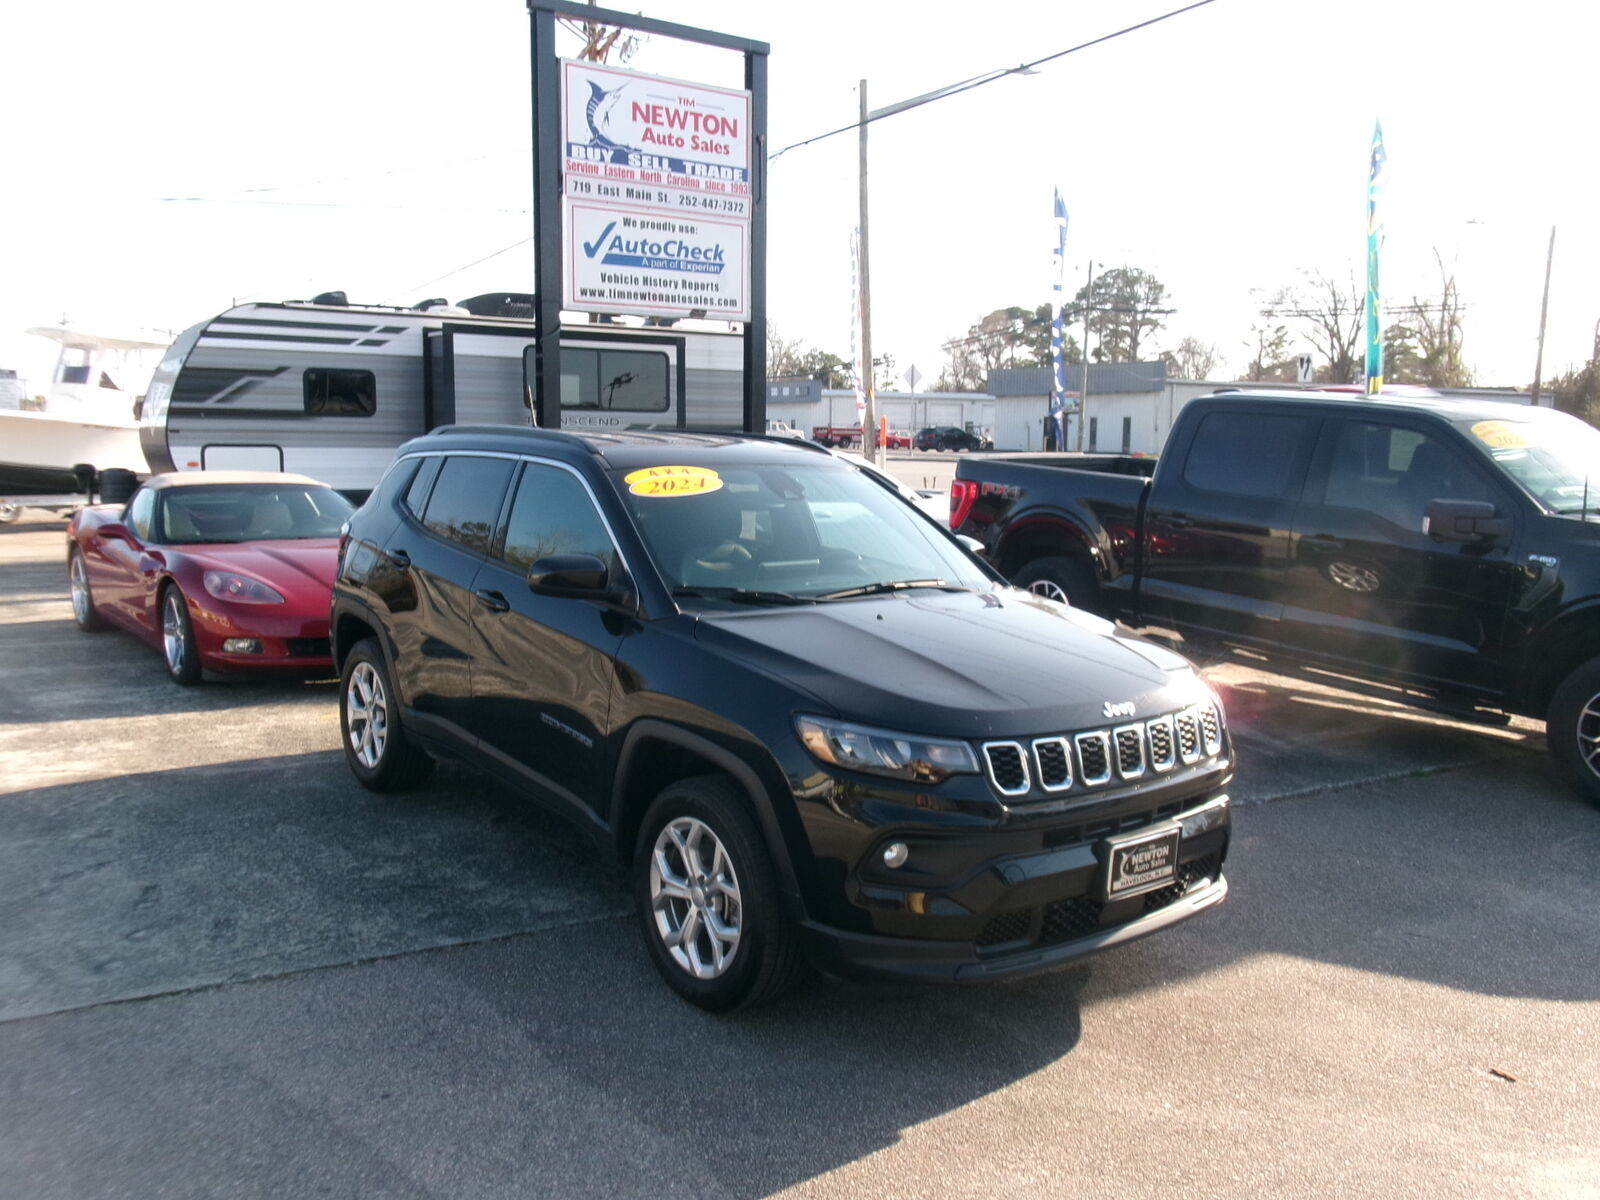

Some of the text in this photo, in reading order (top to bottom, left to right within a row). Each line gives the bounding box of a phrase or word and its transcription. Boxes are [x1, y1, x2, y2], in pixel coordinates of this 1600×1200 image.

[677, 96, 695, 107] TIM
[631, 101, 738, 138] NEWTON
[641, 127, 730, 155] Auto Sales
[570, 144, 744, 182] BUY SELL TRADE
[565, 159, 748, 193] Serving Eastern North Carolina since 1993
[573, 181, 744, 213] 719 East Main St. 252-447-7372
[622, 216, 699, 235] We proudly use:
[608, 235, 725, 262] AutoCheck
[650, 261, 668, 270] part
[680, 263, 720, 273] Experian
[600, 272, 720, 292] Vehicle History Reports
[579, 287, 738, 308] www.timnewtonautosales.com
[1103, 701, 1137, 717] Jeep
[1131, 845, 1170, 865] NEWTON
[1133, 864, 1150, 874] Auto
